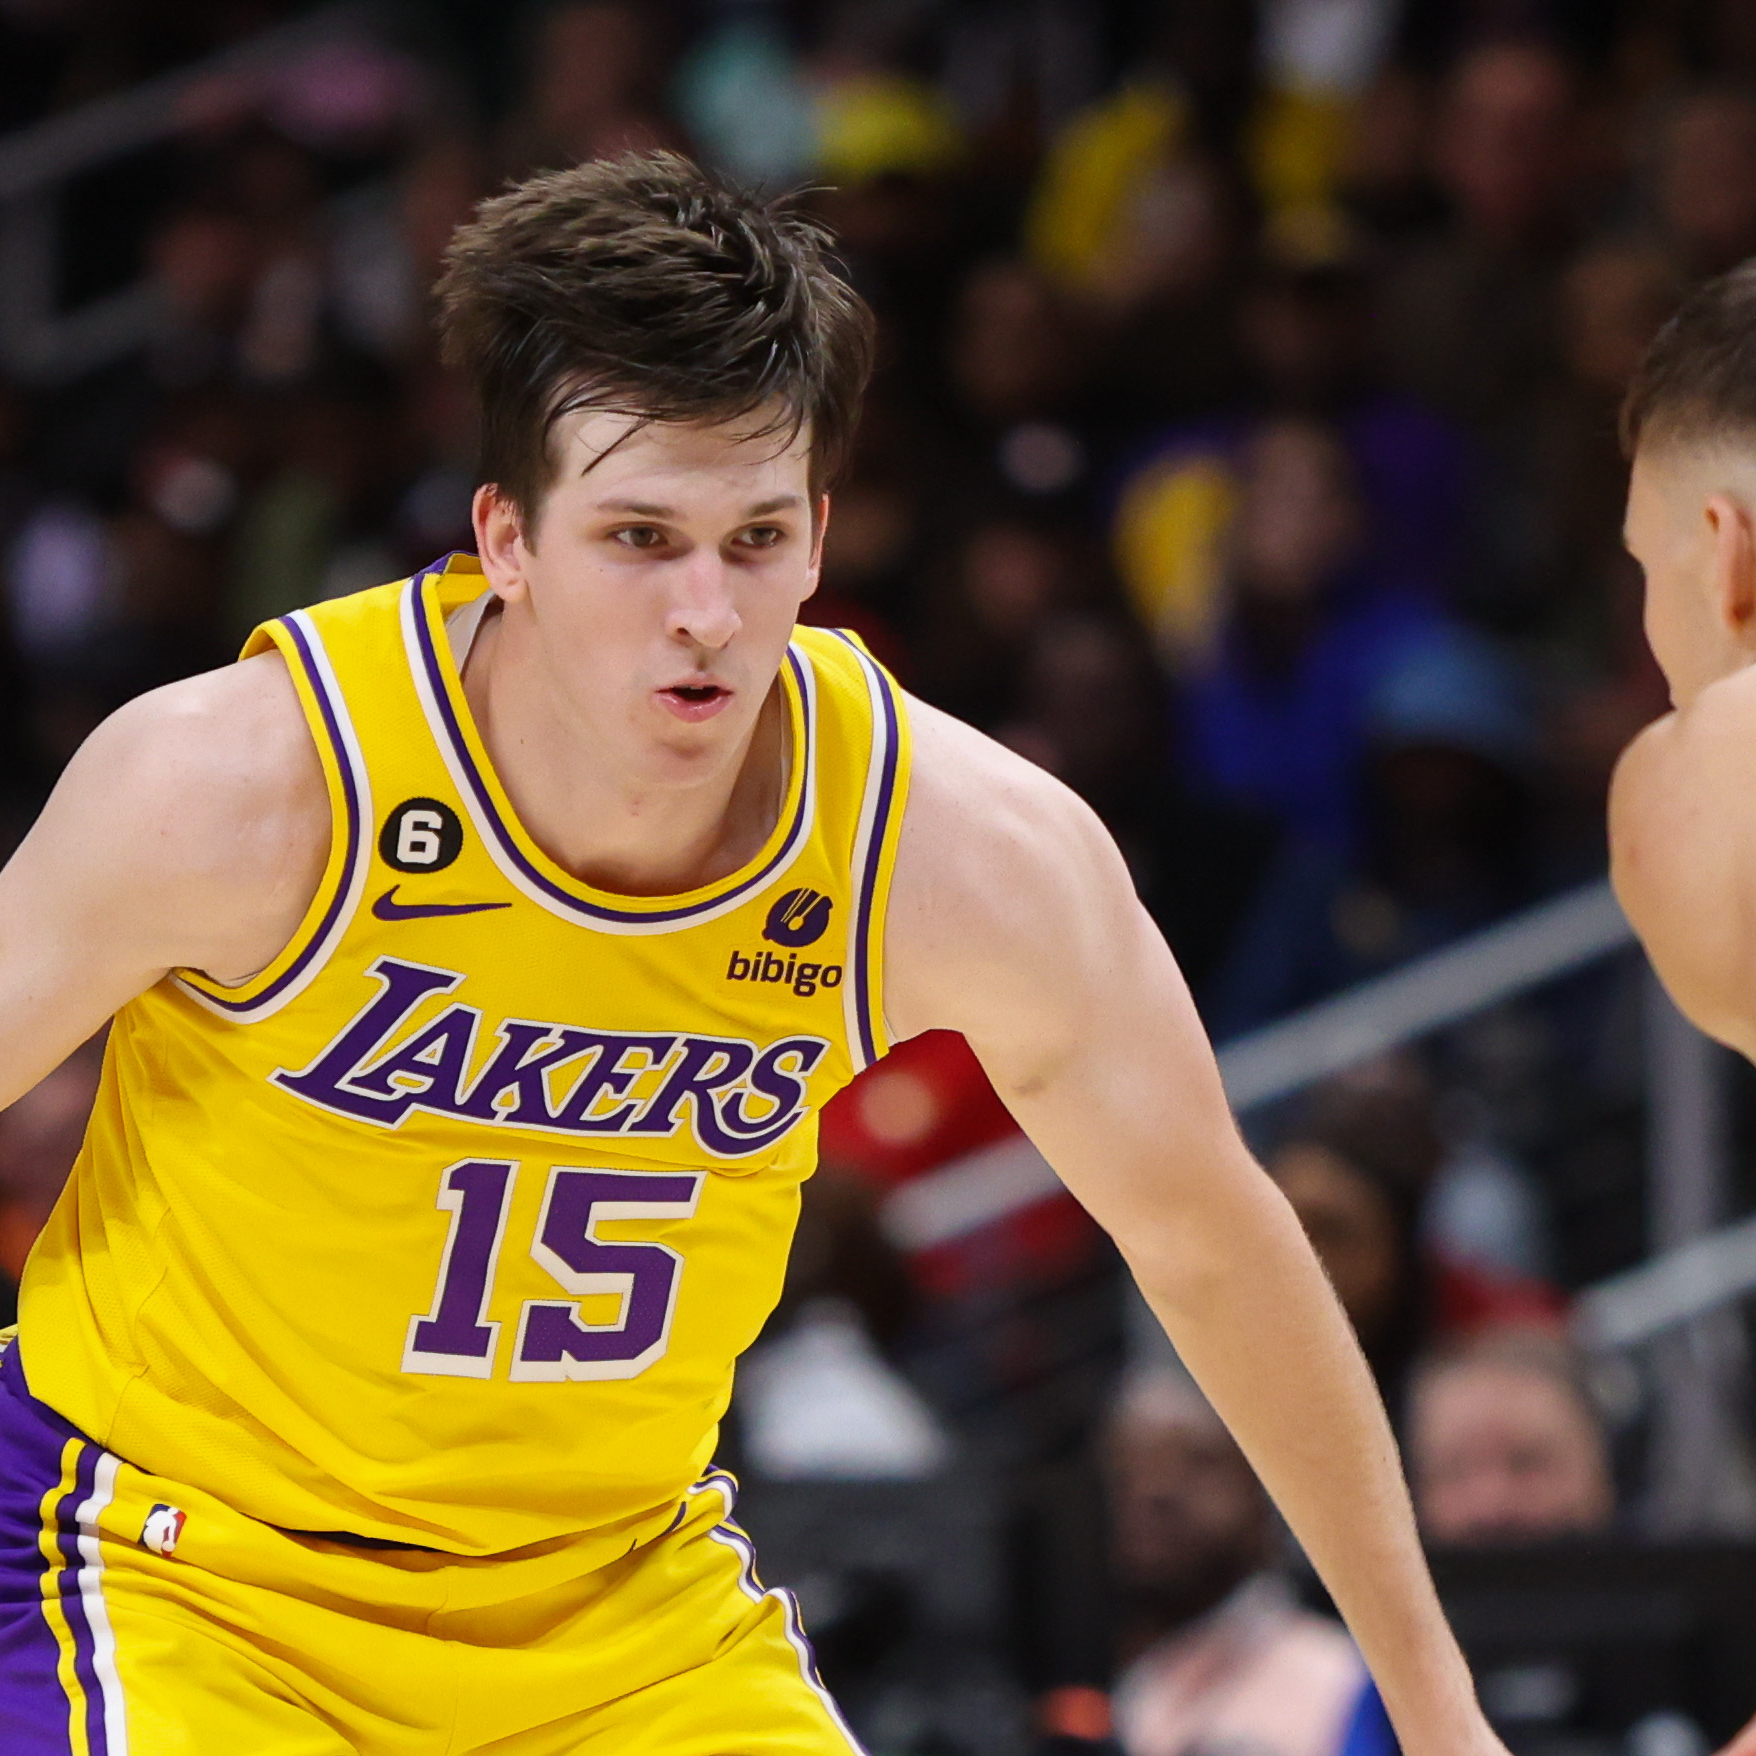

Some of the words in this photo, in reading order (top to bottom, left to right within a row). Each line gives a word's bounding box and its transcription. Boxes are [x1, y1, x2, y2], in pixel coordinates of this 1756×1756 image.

[397, 810, 443, 864] 6
[726, 950, 842, 997] bibigo
[269, 955, 832, 1158] LAKERS
[400, 1158, 705, 1382] 15
